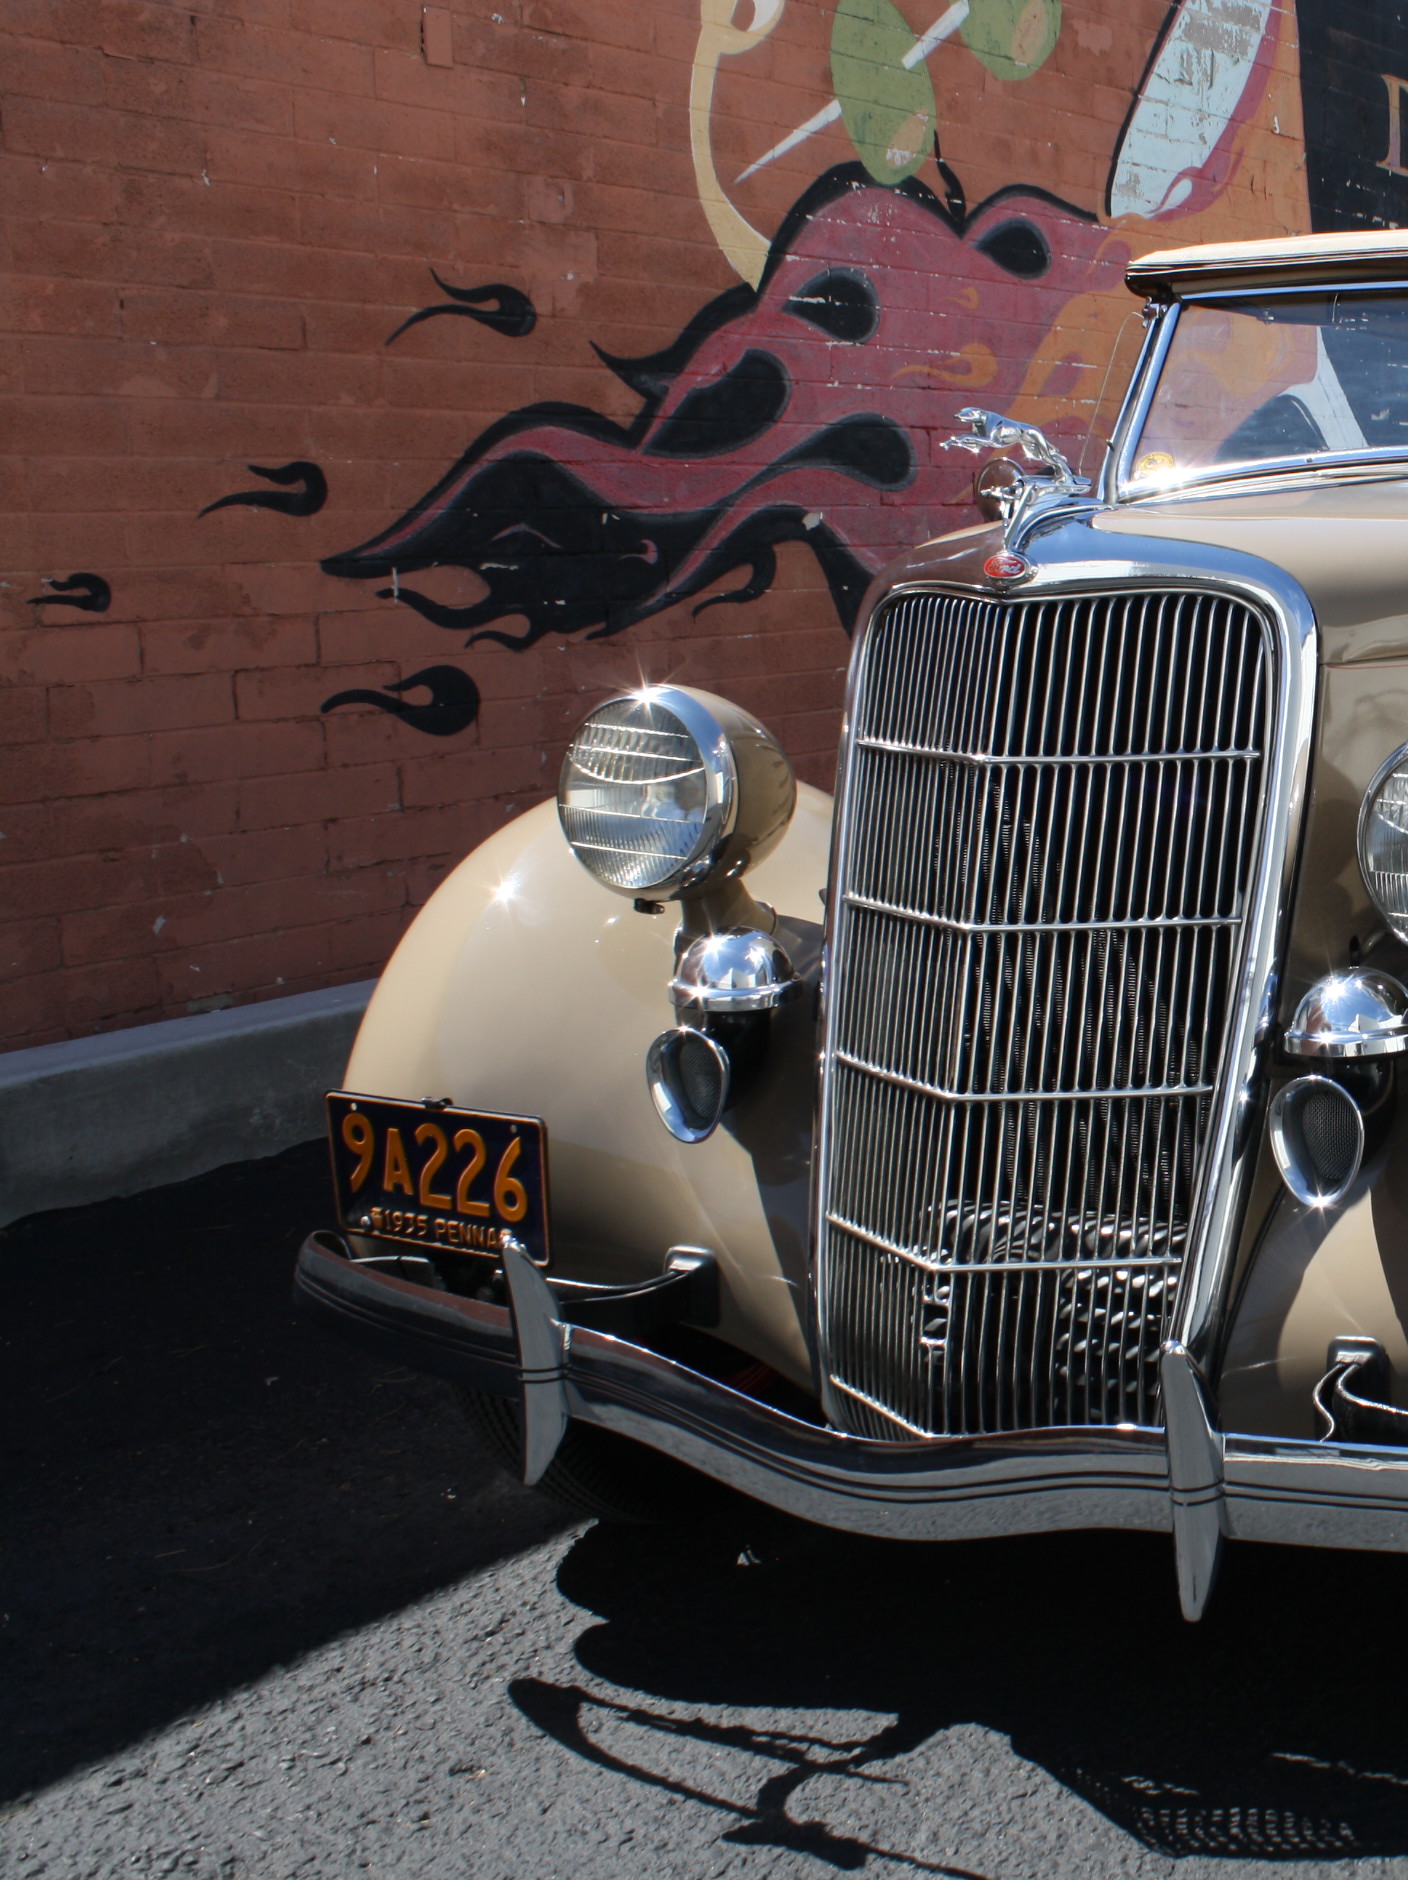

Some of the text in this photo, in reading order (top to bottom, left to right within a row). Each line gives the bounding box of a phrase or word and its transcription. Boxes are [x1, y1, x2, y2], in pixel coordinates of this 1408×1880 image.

[342, 1112, 528, 1223] 9A226
[384, 1209, 497, 1249] 1935 PENNA
